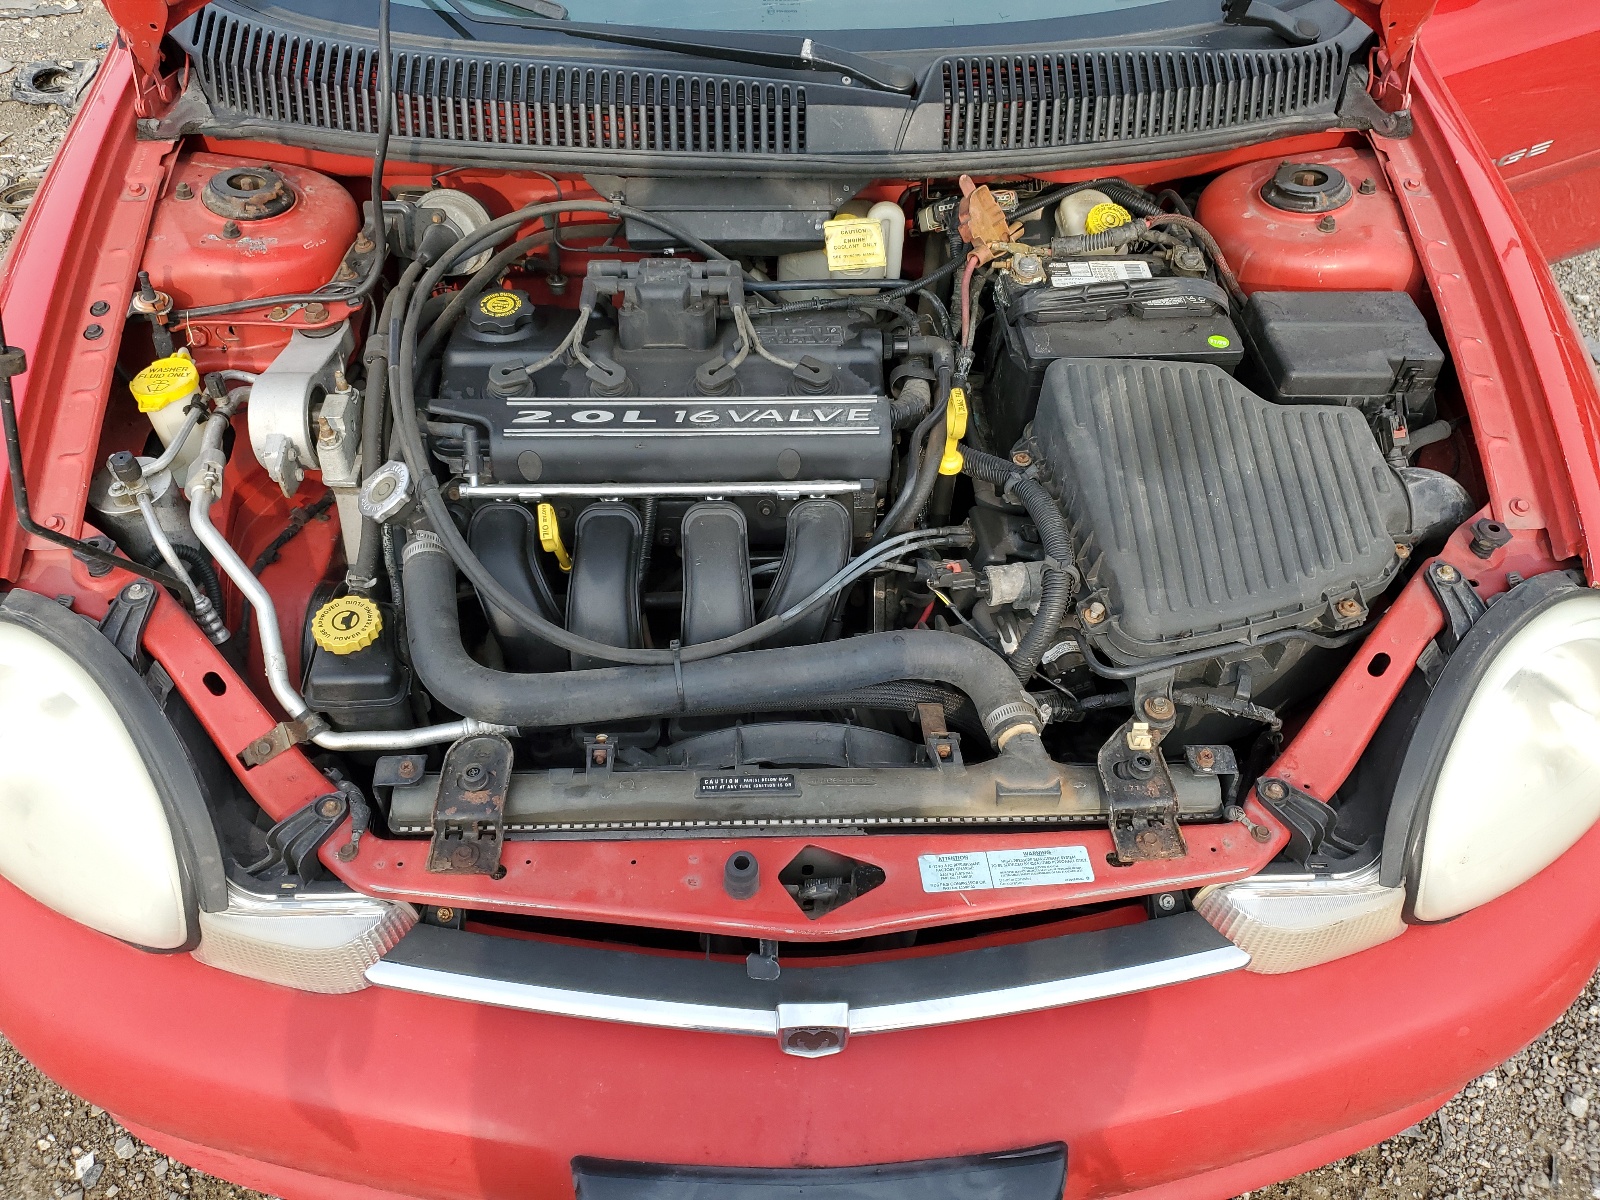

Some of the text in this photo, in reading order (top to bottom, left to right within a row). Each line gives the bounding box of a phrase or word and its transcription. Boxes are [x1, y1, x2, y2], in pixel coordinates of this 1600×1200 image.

[511, 408, 873, 423] 2.0L 16 VALVE
[542, 524, 550, 539] OIL
[318, 600, 373, 641] USE APPROVED POWER STEERING FLUID
